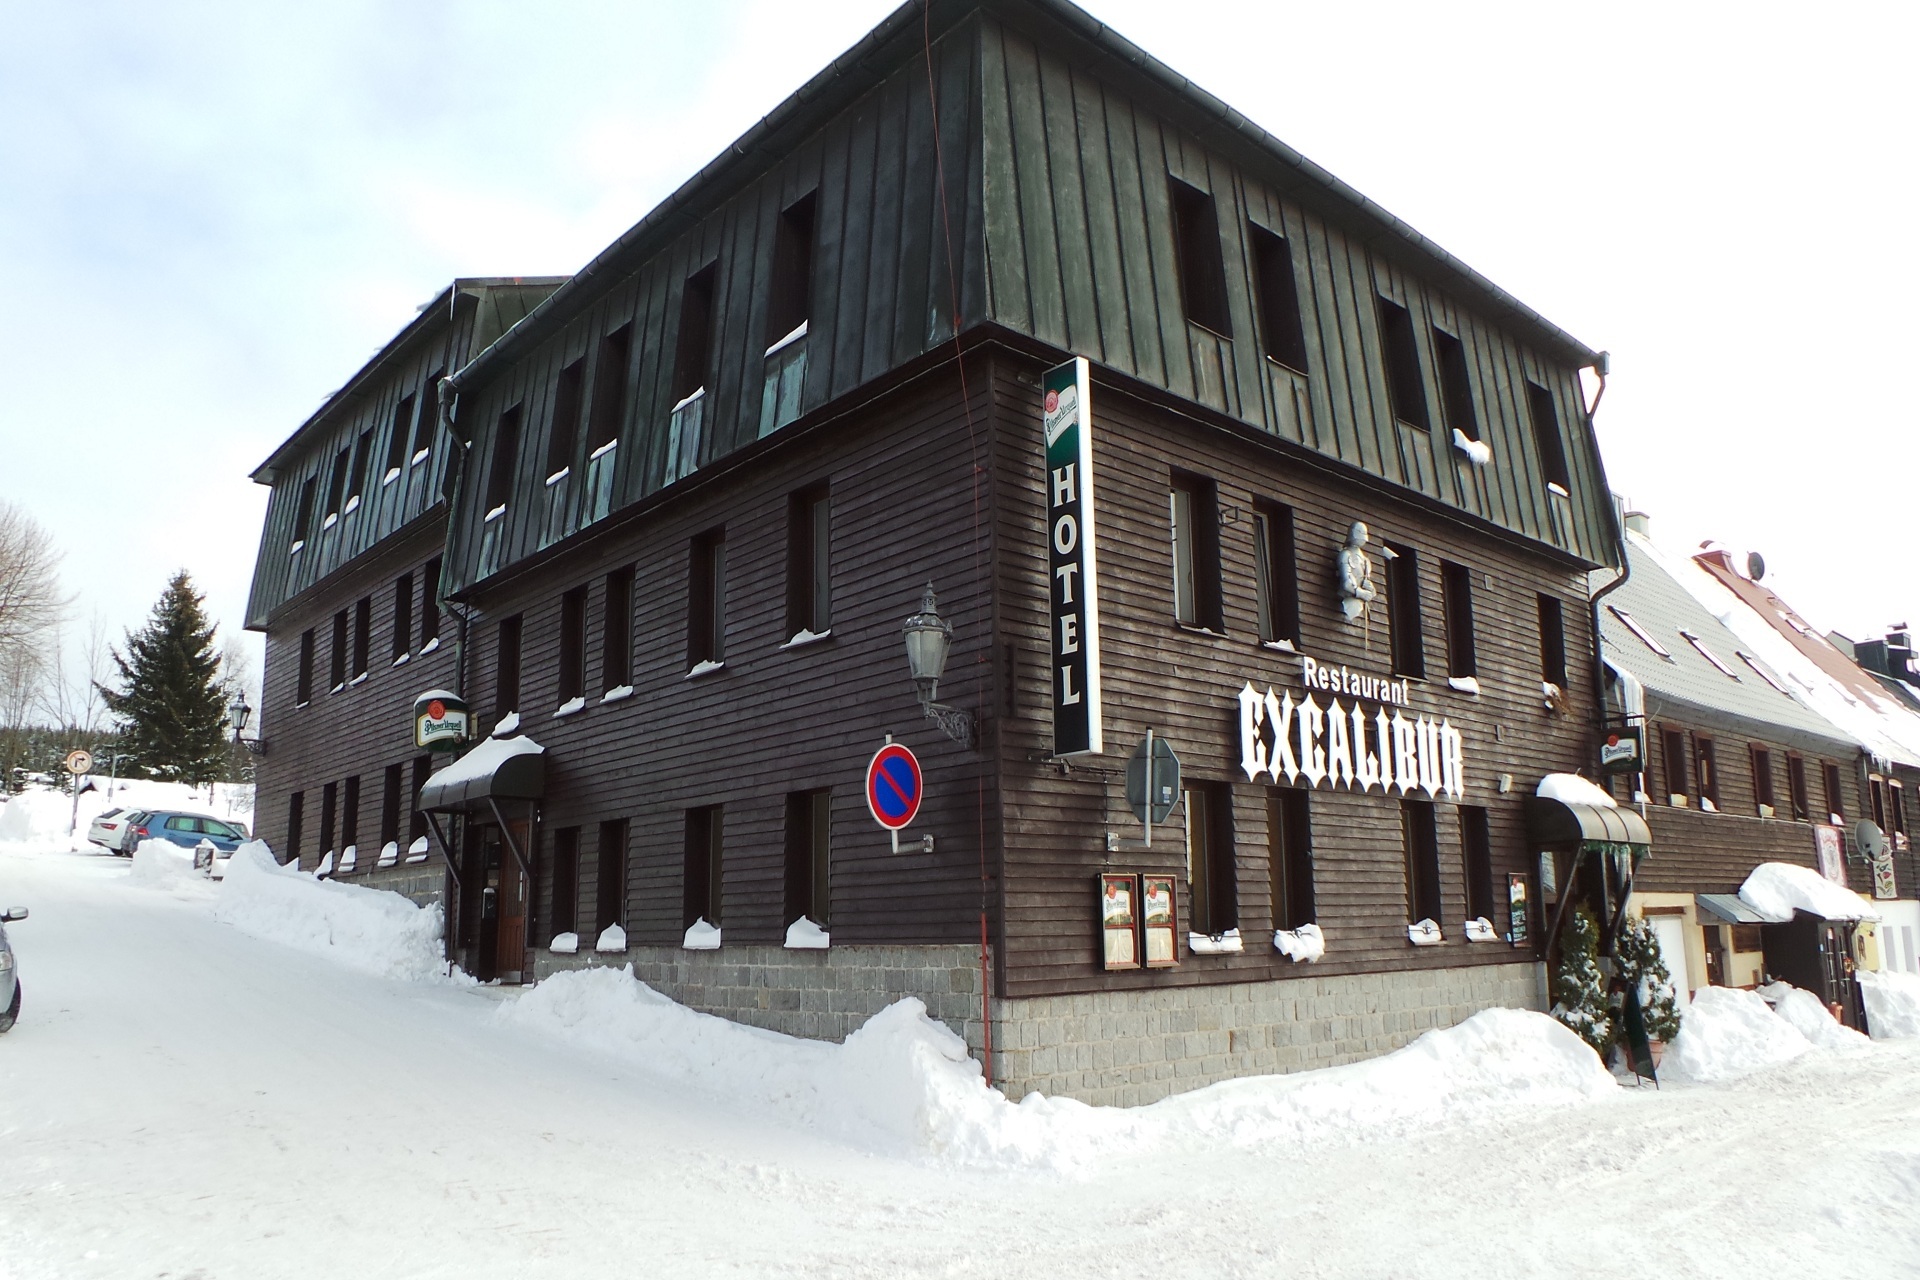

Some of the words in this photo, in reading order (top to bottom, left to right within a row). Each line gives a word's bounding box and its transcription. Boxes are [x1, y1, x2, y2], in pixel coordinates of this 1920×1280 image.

[1052, 463, 1079, 705] HOTEL
[1303, 656, 1409, 705] Restaurant
[1238, 681, 1465, 801] EXCALIBUR
